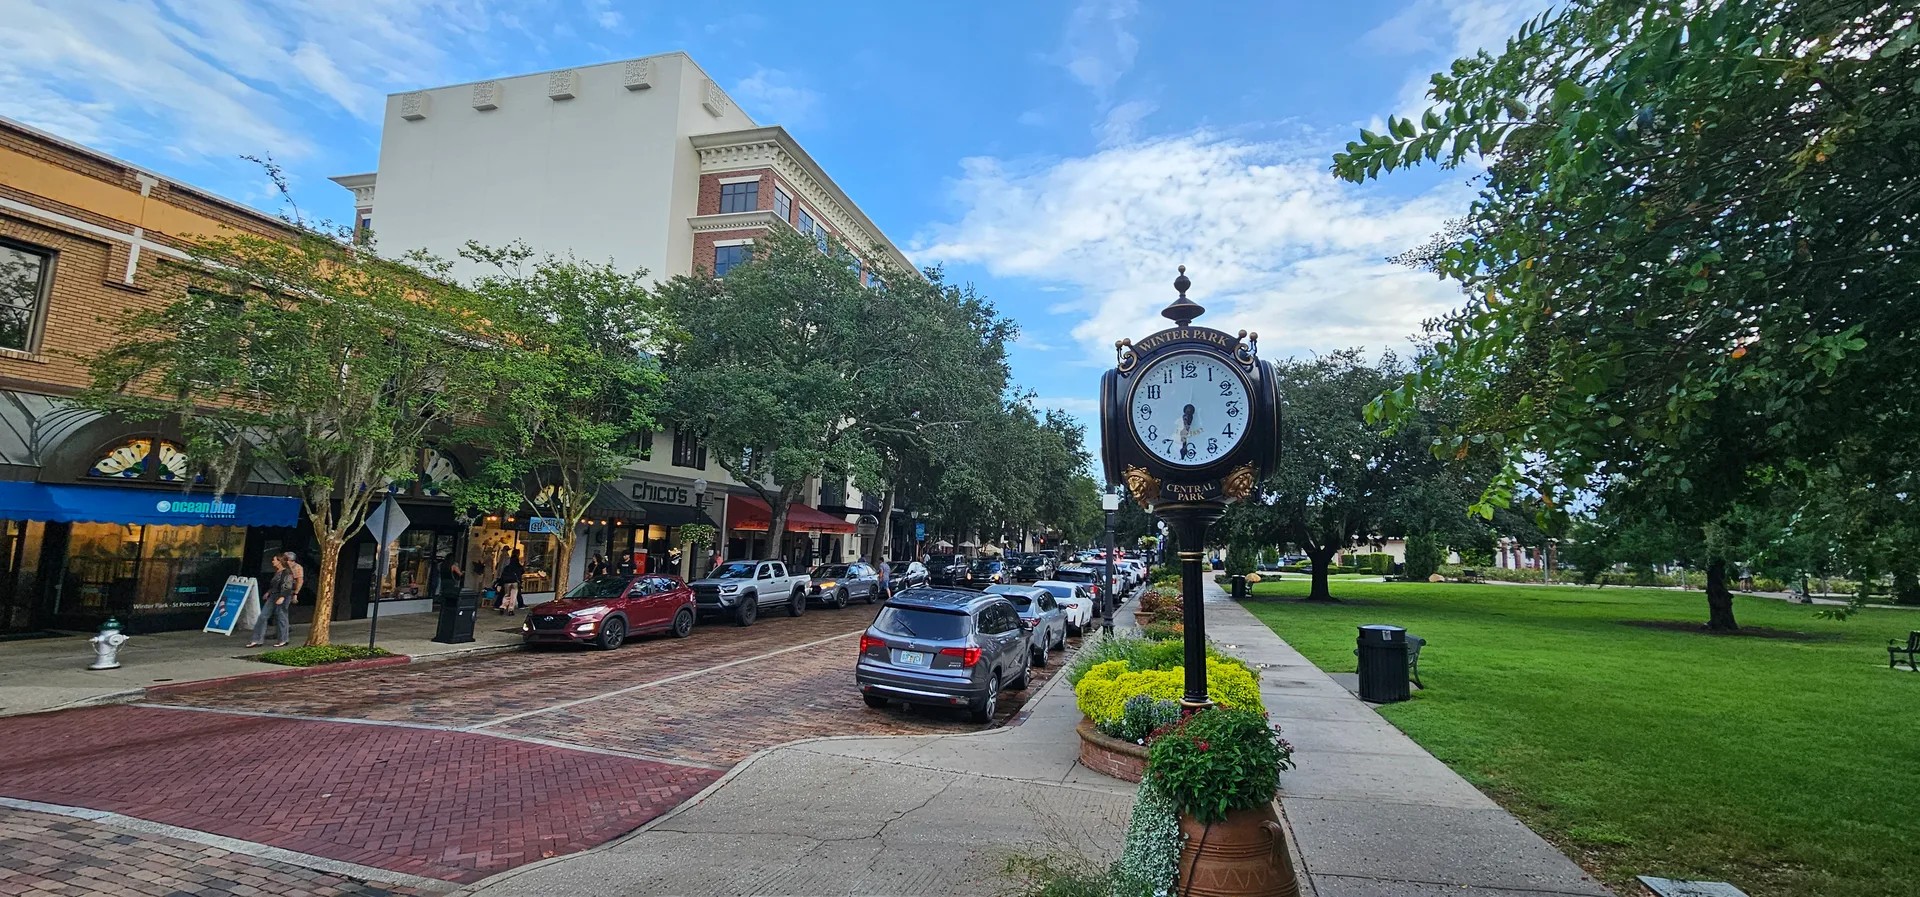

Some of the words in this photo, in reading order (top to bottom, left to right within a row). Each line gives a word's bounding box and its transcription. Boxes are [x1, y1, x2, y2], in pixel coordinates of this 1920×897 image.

[1139, 329, 1189, 352] WINTER
[1193, 329, 1229, 346] PARK
[1163, 369, 1173, 384] 11
[1181, 362, 1198, 378] 12
[1208, 367, 1213, 382] 1
[1147, 384, 1161, 399] 10
[1219, 380, 1233, 396] 2
[1140, 404, 1152, 420] 9
[1225, 400, 1240, 418] 3
[1147, 424, 1158, 441] 8
[1222, 422, 1234, 439] 4
[1162, 438, 1174, 454] 7
[1186, 442, 1197, 459] 6
[1206, 438, 1218, 454] 5
[1166, 483, 1215, 493] CENTRAL
[1177, 492, 1206, 501] PARK
